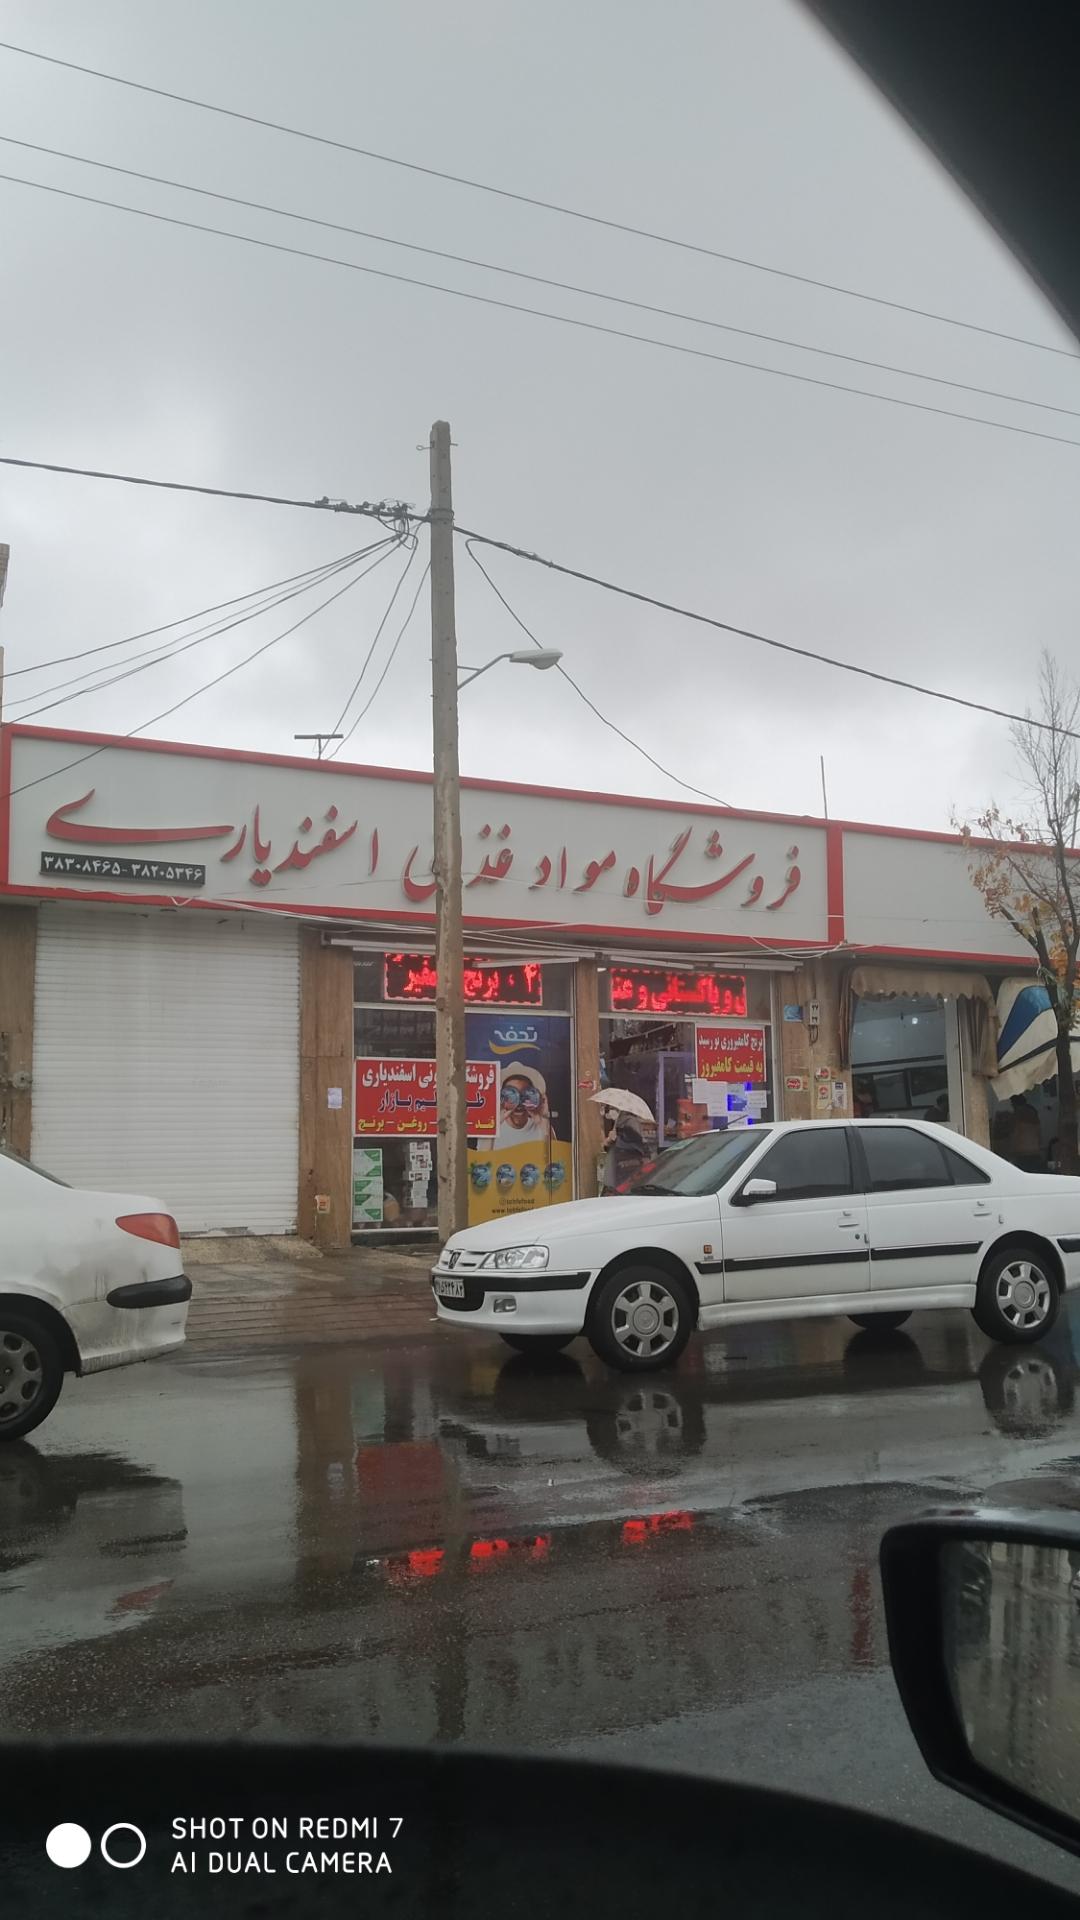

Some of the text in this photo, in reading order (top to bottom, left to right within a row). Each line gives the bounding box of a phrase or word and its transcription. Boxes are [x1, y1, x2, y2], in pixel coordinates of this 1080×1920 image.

[46, 788, 801, 916] فروشگاه مواد غذی اسفندیاری
[493, 1025, 538, 1042] تحفه
[750, 1033, 763, 1051] برنج
[362, 1062, 417, 1088] اسفندیاری
[701, 1056, 733, 1077] کامفیروز
[734, 1055, 754, 1077] قیمت
[377, 1088, 413, 1113] بازار
[358, 1115, 385, 1132] برنج
[397, 1115, 427, 1132] روغن
[475, 1115, 496, 1130] قند
